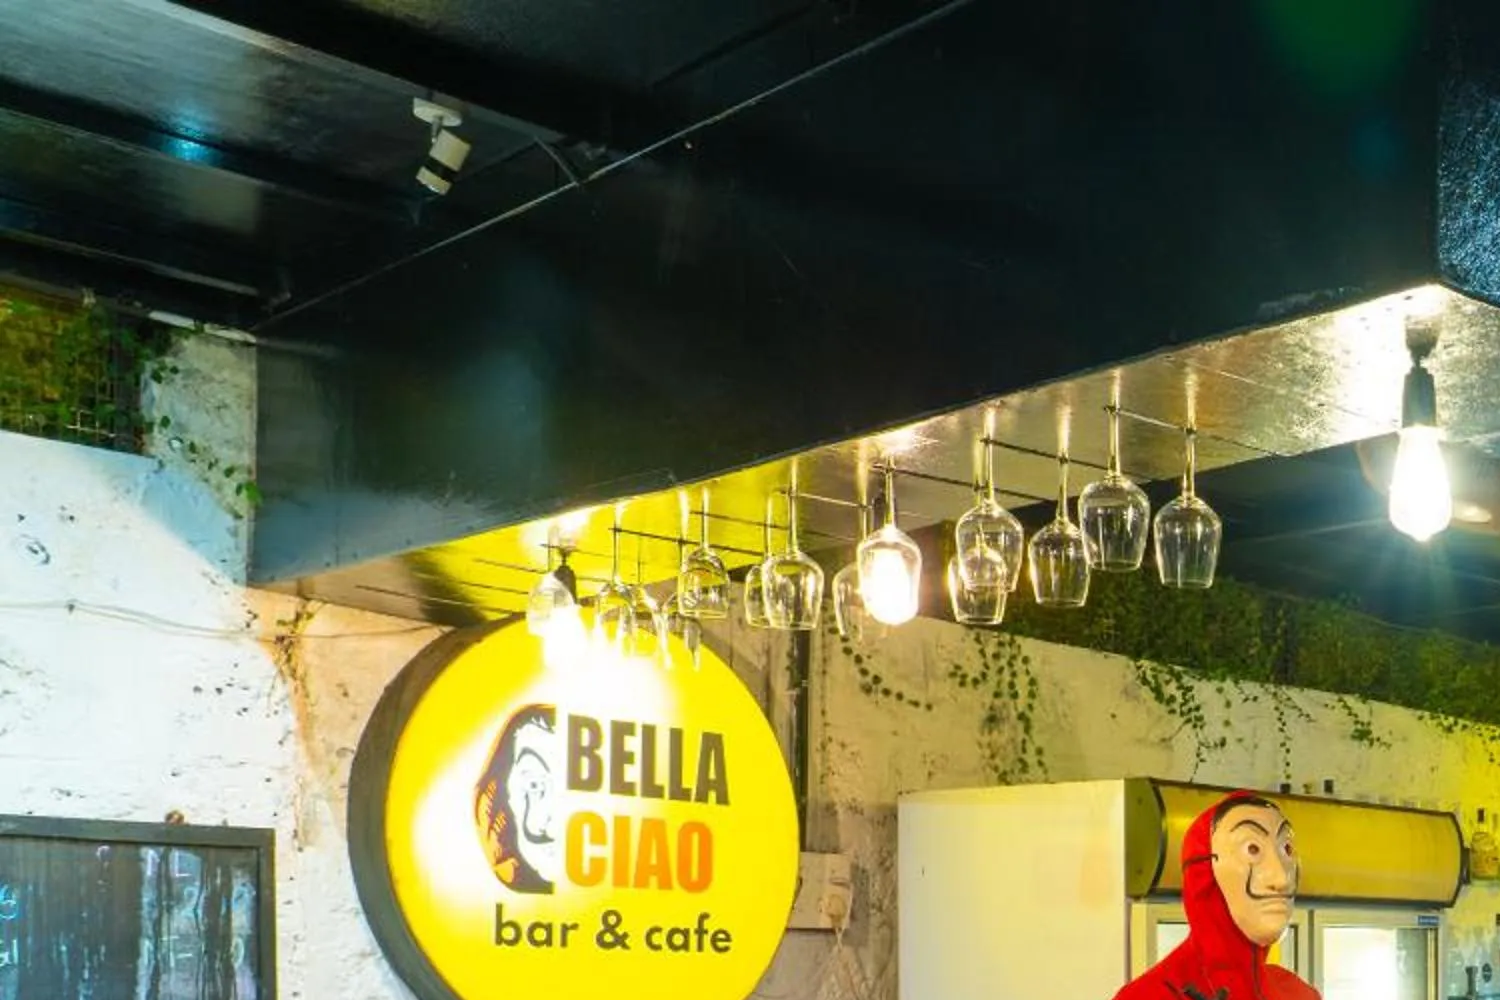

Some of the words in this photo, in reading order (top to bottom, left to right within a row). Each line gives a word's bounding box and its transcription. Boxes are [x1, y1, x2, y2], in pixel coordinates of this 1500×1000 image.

[567, 713, 731, 806] BELLA
[564, 809, 714, 894] CIAO
[495, 903, 579, 948] bar
[595, 909, 631, 951] &
[645, 912, 733, 954] cafe
